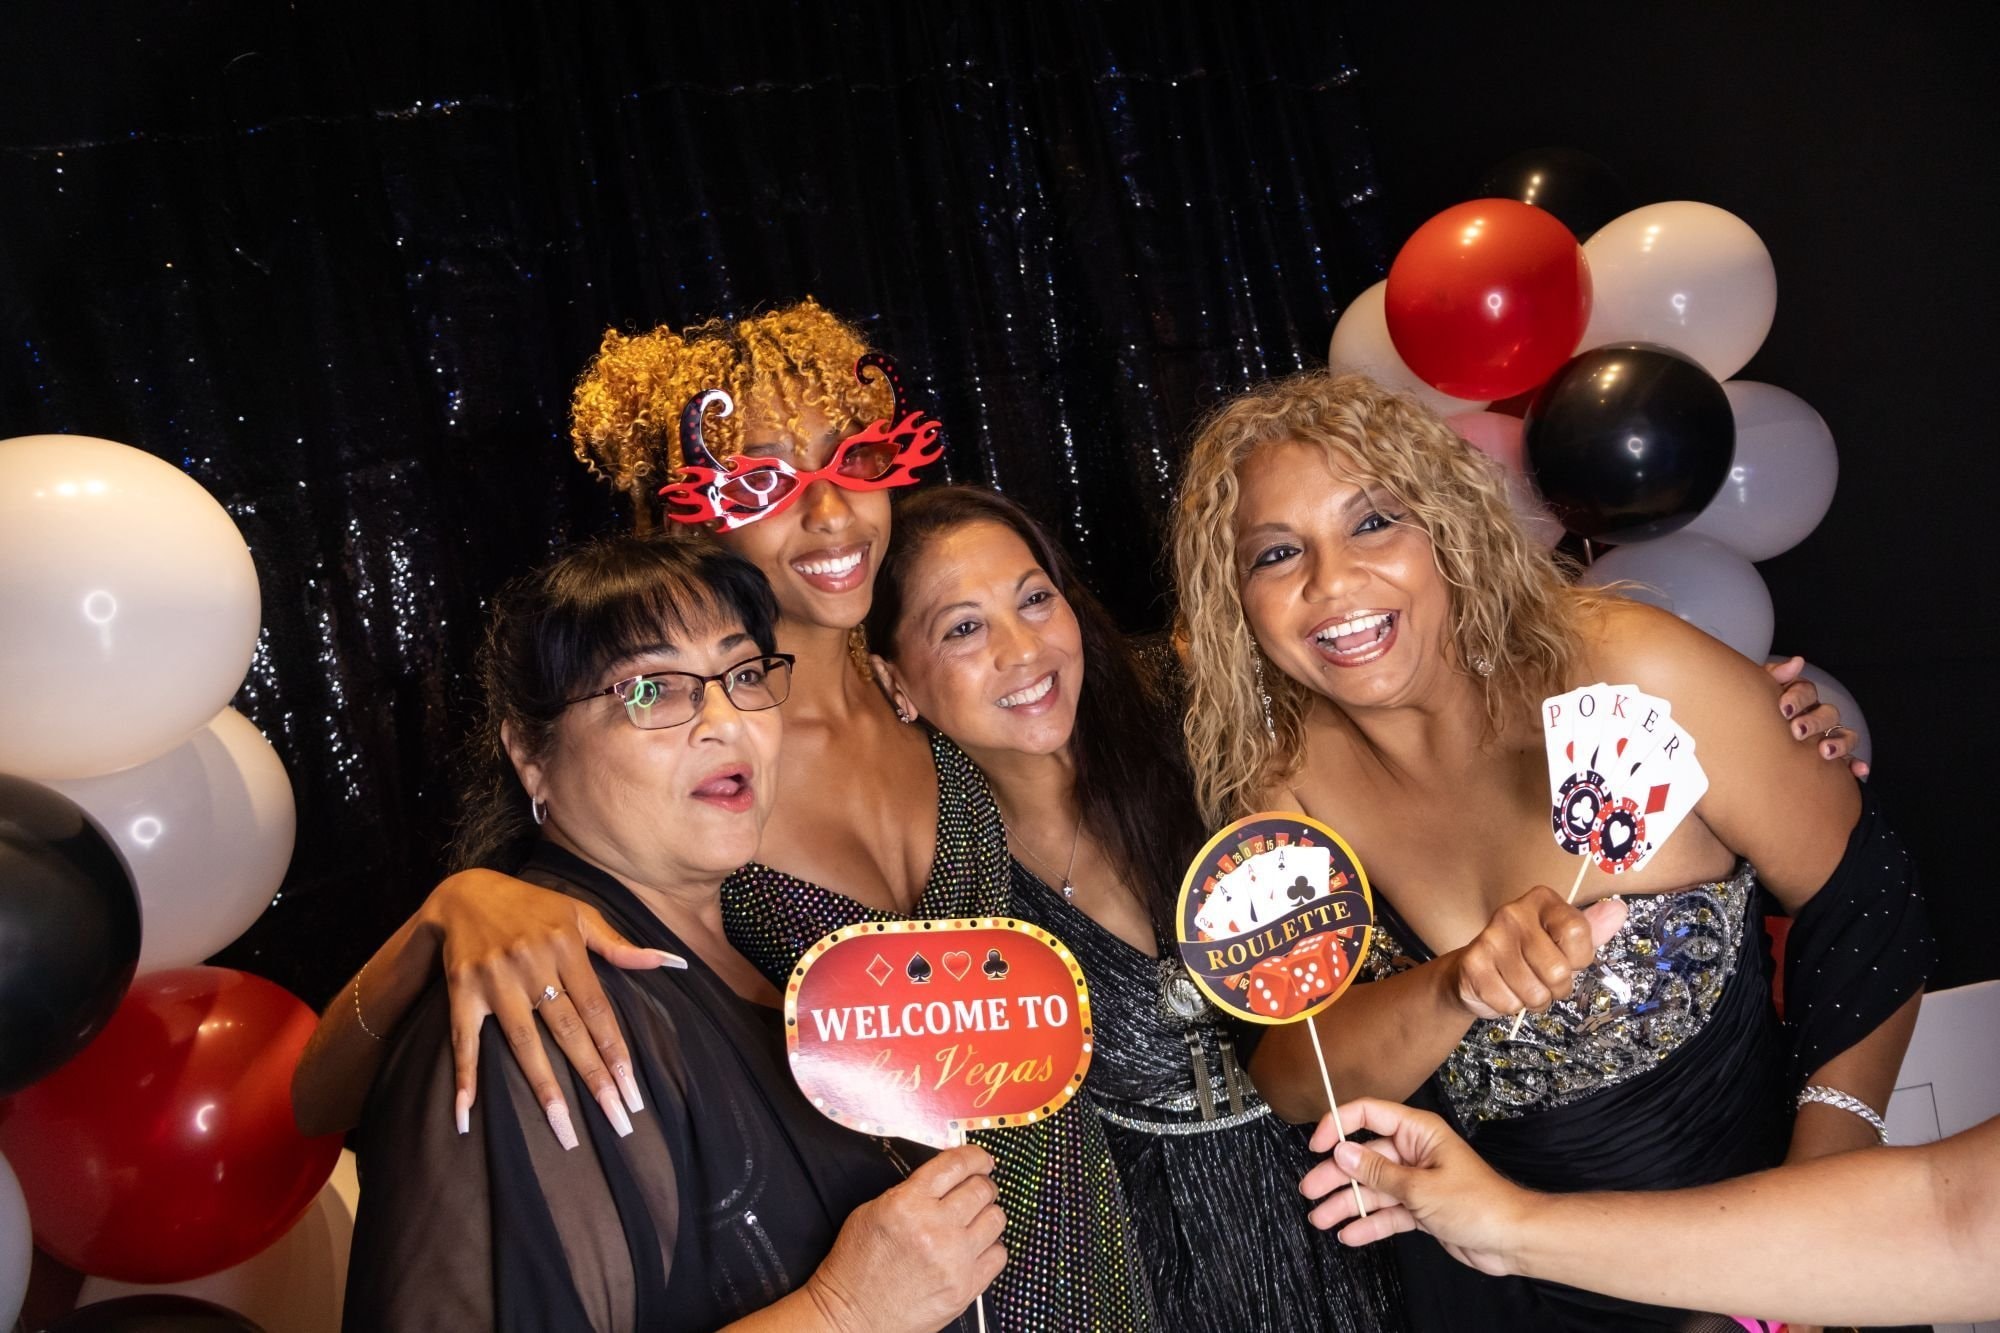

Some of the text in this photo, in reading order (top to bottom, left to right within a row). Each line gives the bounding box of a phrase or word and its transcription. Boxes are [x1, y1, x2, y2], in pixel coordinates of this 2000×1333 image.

[1548, 694, 1680, 761] POKER
[1232, 851, 1244, 865] 26
[1244, 847, 1252, 858] 0
[1254, 841, 1264, 854] 32
[1266, 839, 1274, 851] 15
[1205, 901, 1351, 972] ROULETTE
[811, 994, 1069, 1042] WELCOME TO
[933, 1044, 1053, 1108] Vegas
